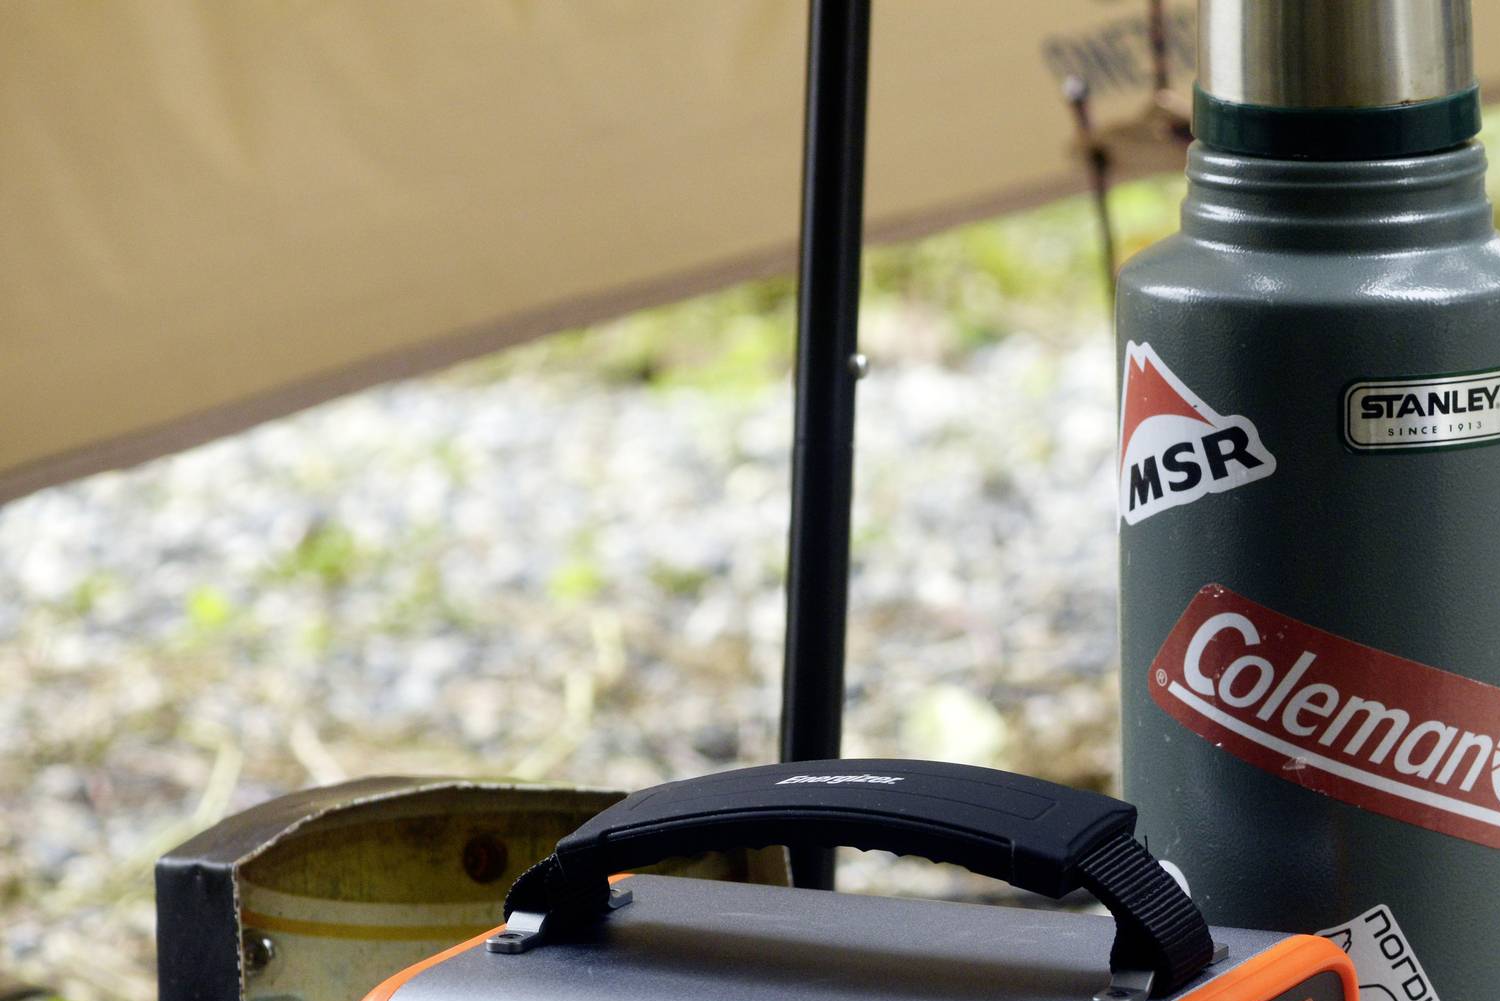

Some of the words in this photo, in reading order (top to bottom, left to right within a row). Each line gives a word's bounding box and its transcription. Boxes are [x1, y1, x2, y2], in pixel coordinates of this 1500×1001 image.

[1361, 384, 1500, 420] STANLEY
[1387, 425, 1438, 437] SINCE
[1448, 422, 1483, 433] 1913
[1129, 425, 1264, 512] MSR
[1183, 612, 1495, 793] Coleman
[775, 773, 905, 786] Energizer
